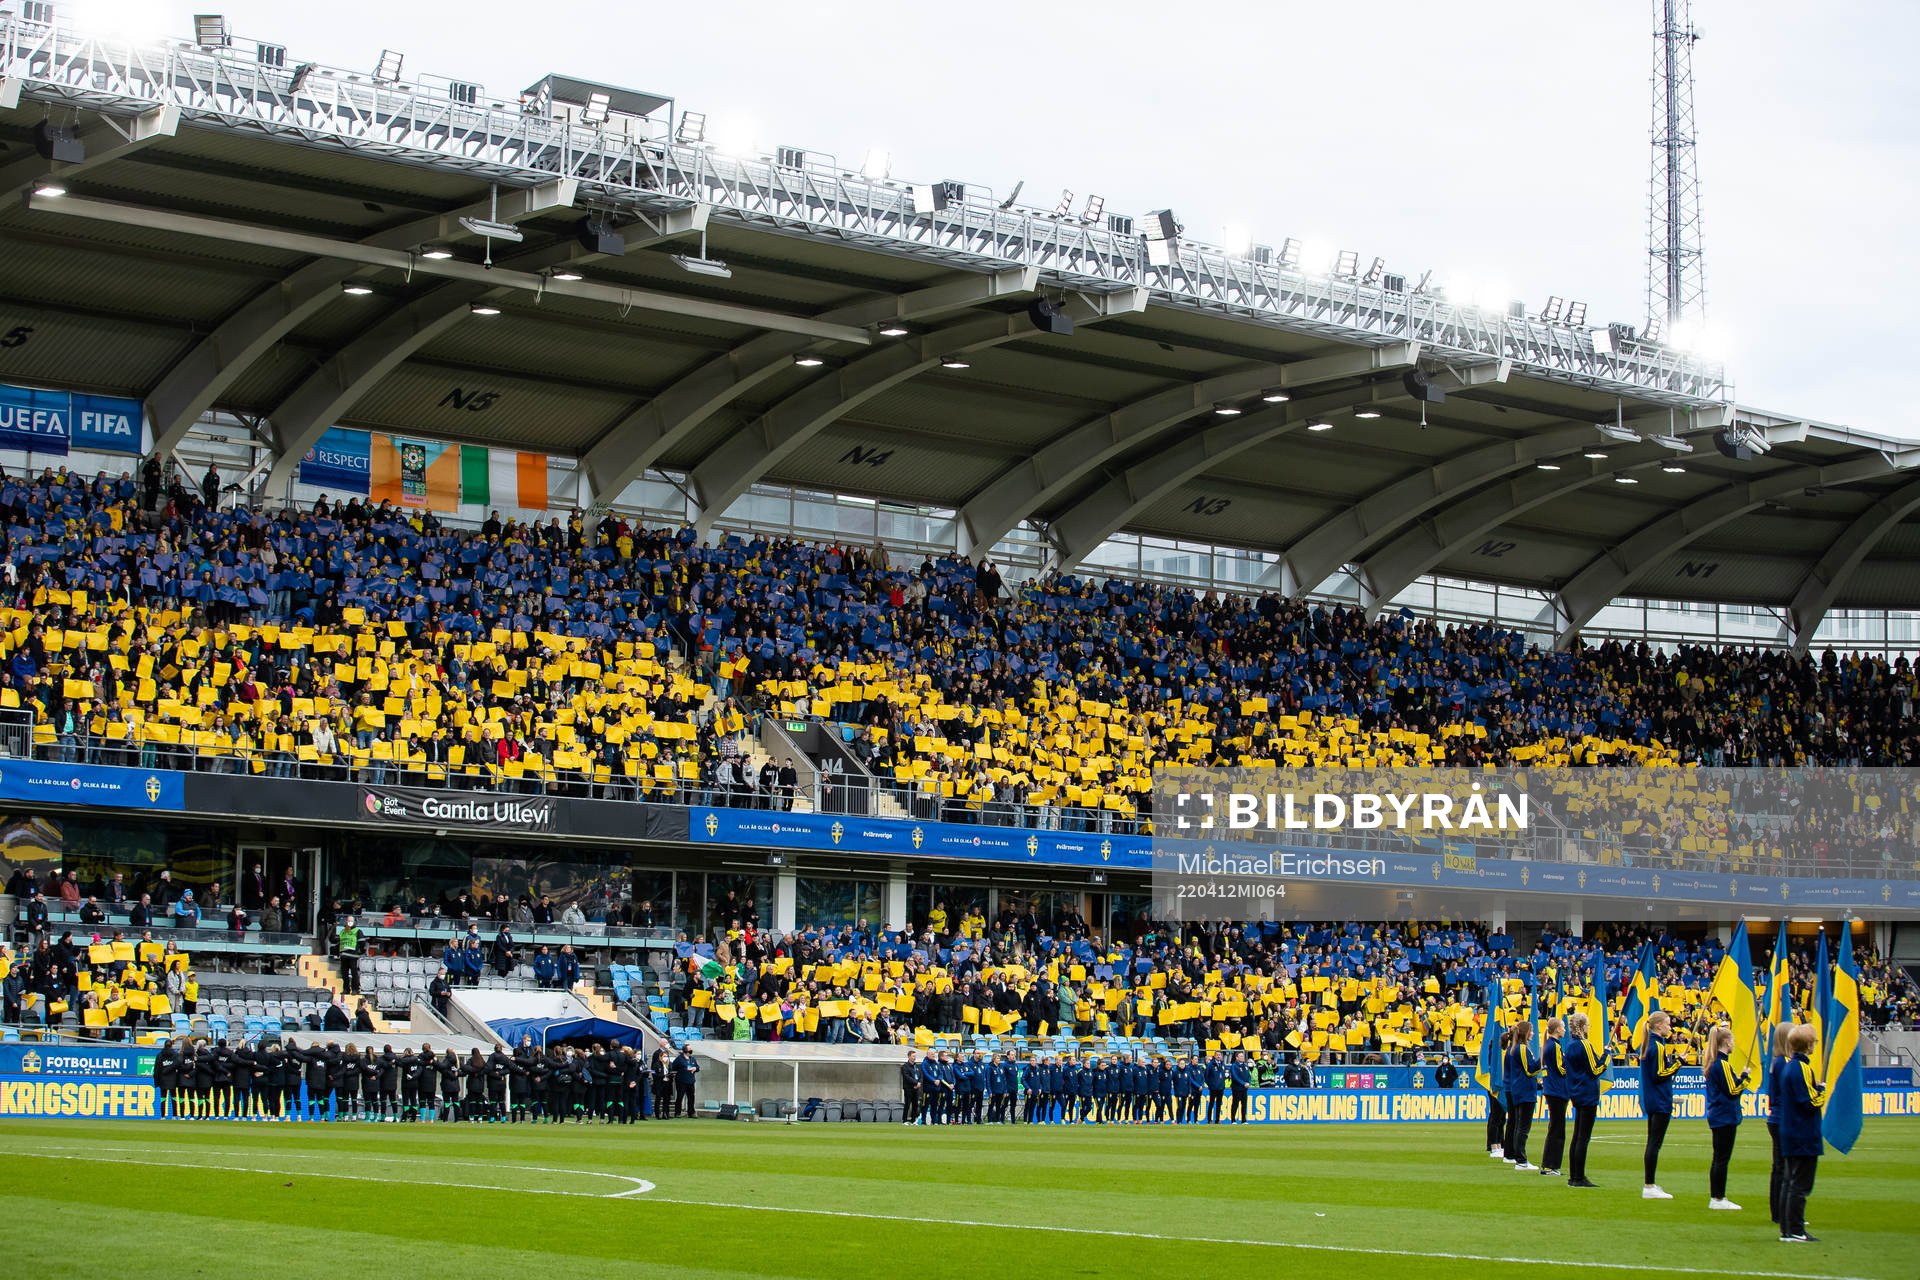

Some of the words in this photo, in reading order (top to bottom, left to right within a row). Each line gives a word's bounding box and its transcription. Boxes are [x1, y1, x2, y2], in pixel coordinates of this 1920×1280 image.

[438, 388, 501, 411] N5
[0, 406, 65, 434] UEFA
[81, 411, 132, 436] FIFA
[319, 450, 369, 469] RESPECT
[838, 446, 894, 467] N4
[1182, 496, 1232, 515] N3
[1471, 540, 1517, 558] N2
[1675, 561, 1718, 578] N1
[821, 758, 844, 776] N4
[384, 797, 399, 807] Got
[384, 806, 407, 817] Event
[422, 798, 488, 821] Gamla
[494, 802, 549, 824] Ullevi
[46, 1056, 120, 1069] FOTBOLLEN
[123, 1058, 127, 1069] I
[0, 1081, 155, 1117] KRIGSOFFER
[1269, 1094, 1358, 1121] INSAMLING
[1360, 1095, 1389, 1120] TILL
[1392, 1093, 1456, 1120] FÖRMÅN
[1458, 1093, 1487, 1119] FÖR
[1671, 1093, 1706, 1118] STÖD
[1883, 1092, 1905, 1114] TILL
